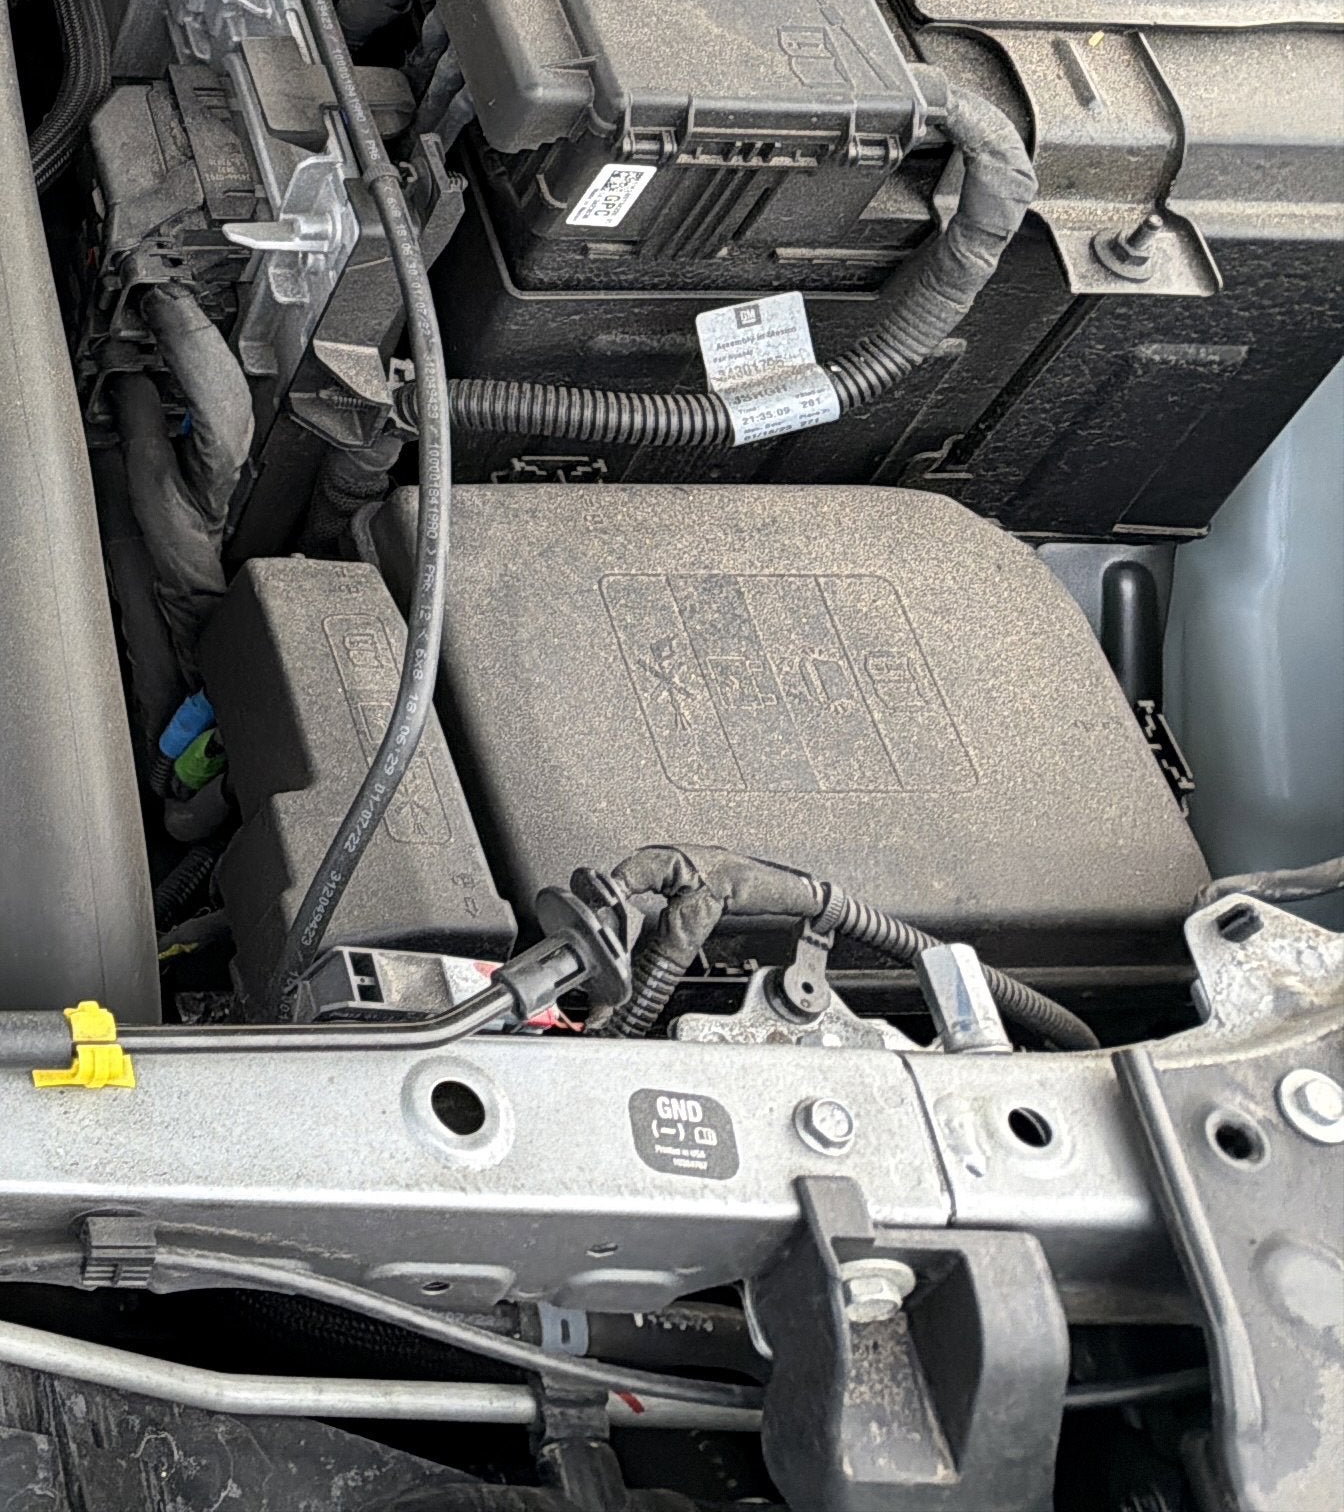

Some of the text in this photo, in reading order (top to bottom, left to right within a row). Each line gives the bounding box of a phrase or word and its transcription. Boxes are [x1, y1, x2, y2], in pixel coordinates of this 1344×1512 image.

[594, 195, 621, 216] GPC
[740, 308, 756, 321] GM
[343, 783, 386, 854] 01/07/22
[300, 870, 343, 947] 312049423
[656, 1096, 703, 1123] GND
